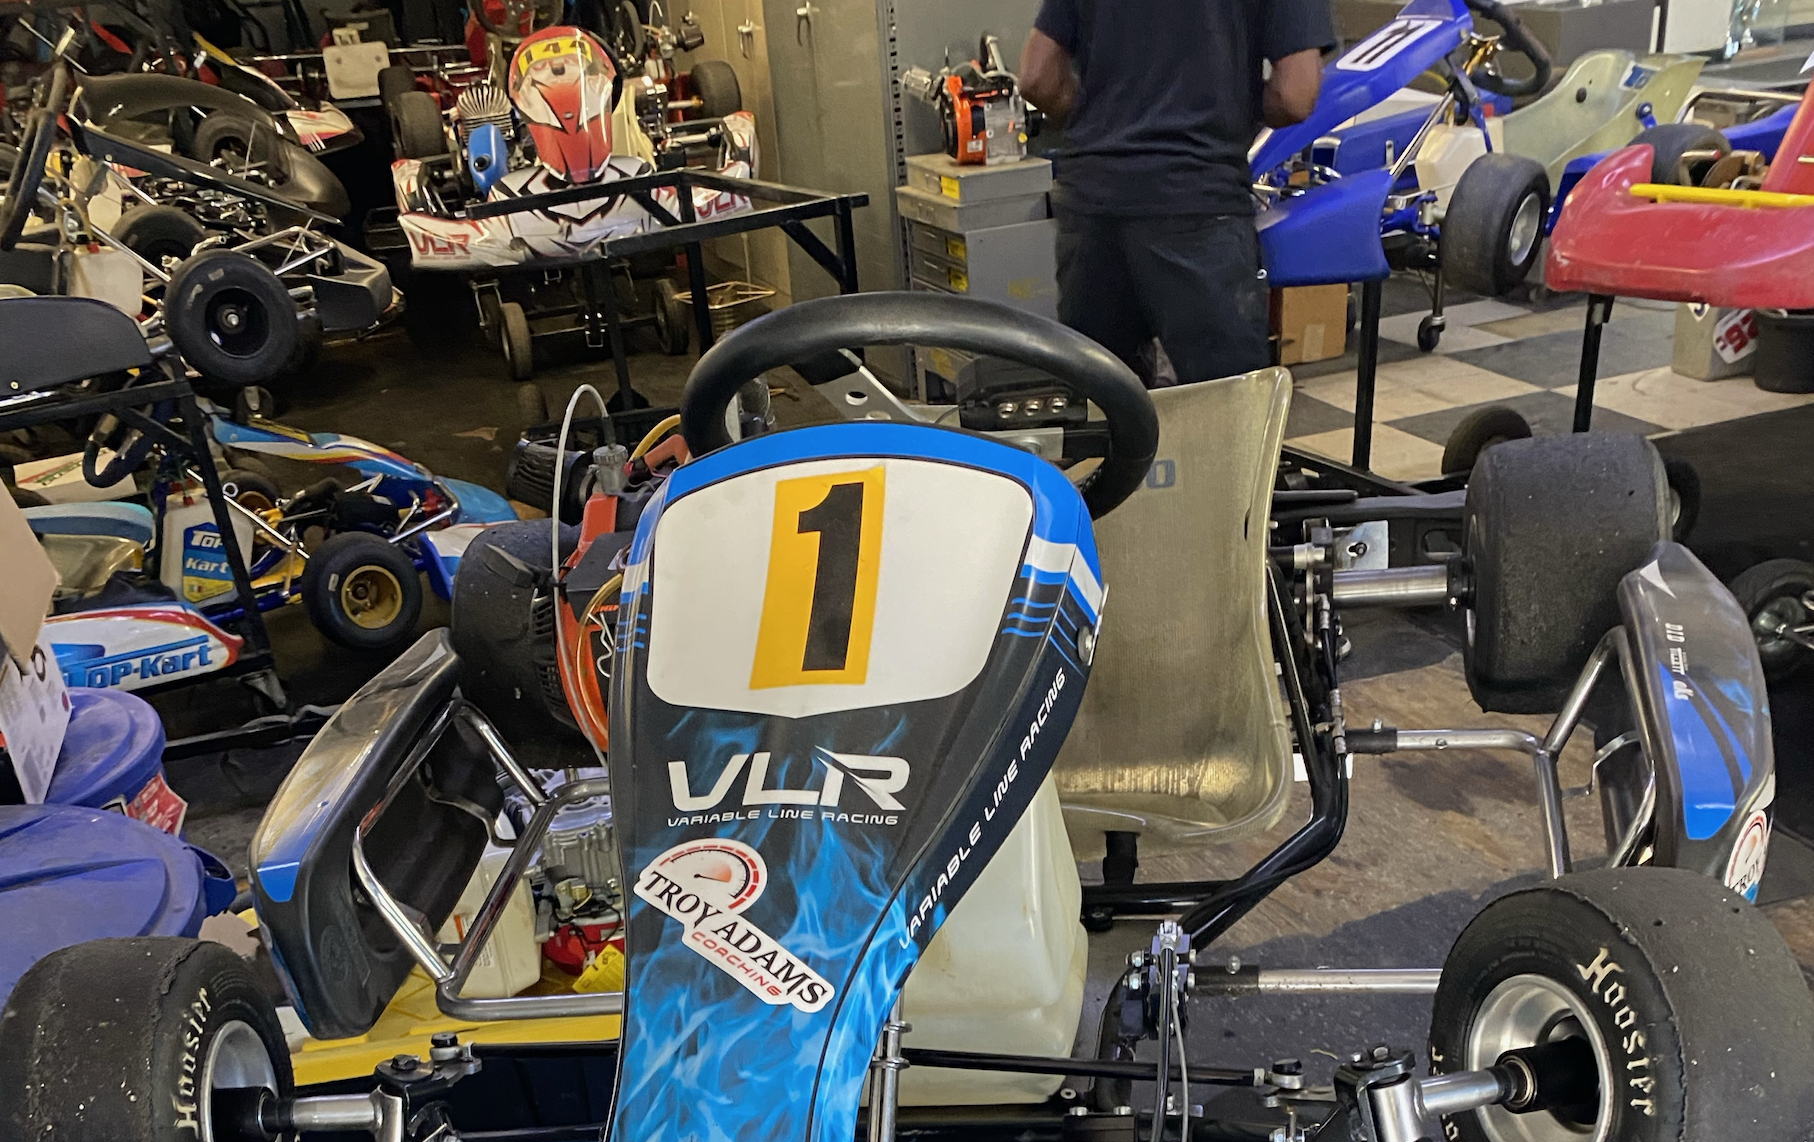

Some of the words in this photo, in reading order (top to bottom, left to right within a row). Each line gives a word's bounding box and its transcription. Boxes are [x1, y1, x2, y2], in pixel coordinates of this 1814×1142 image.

[409, 232, 471, 255] VLR
[185, 557, 230, 574] Kart
[797, 482, 864, 671] 1
[668, 745, 910, 812] VLR
[899, 821, 983, 949] VARIABLE
[984, 759, 1018, 822] LINE
[1019, 667, 1066, 761] RACING
[667, 809, 761, 827] VARIABLE
[768, 809, 814, 820] LINE
[821, 810, 899, 825] RACING
[644, 871, 723, 929] TROY
[711, 921, 828, 1005] ADAMS
[691, 931, 783, 997] COACHING
